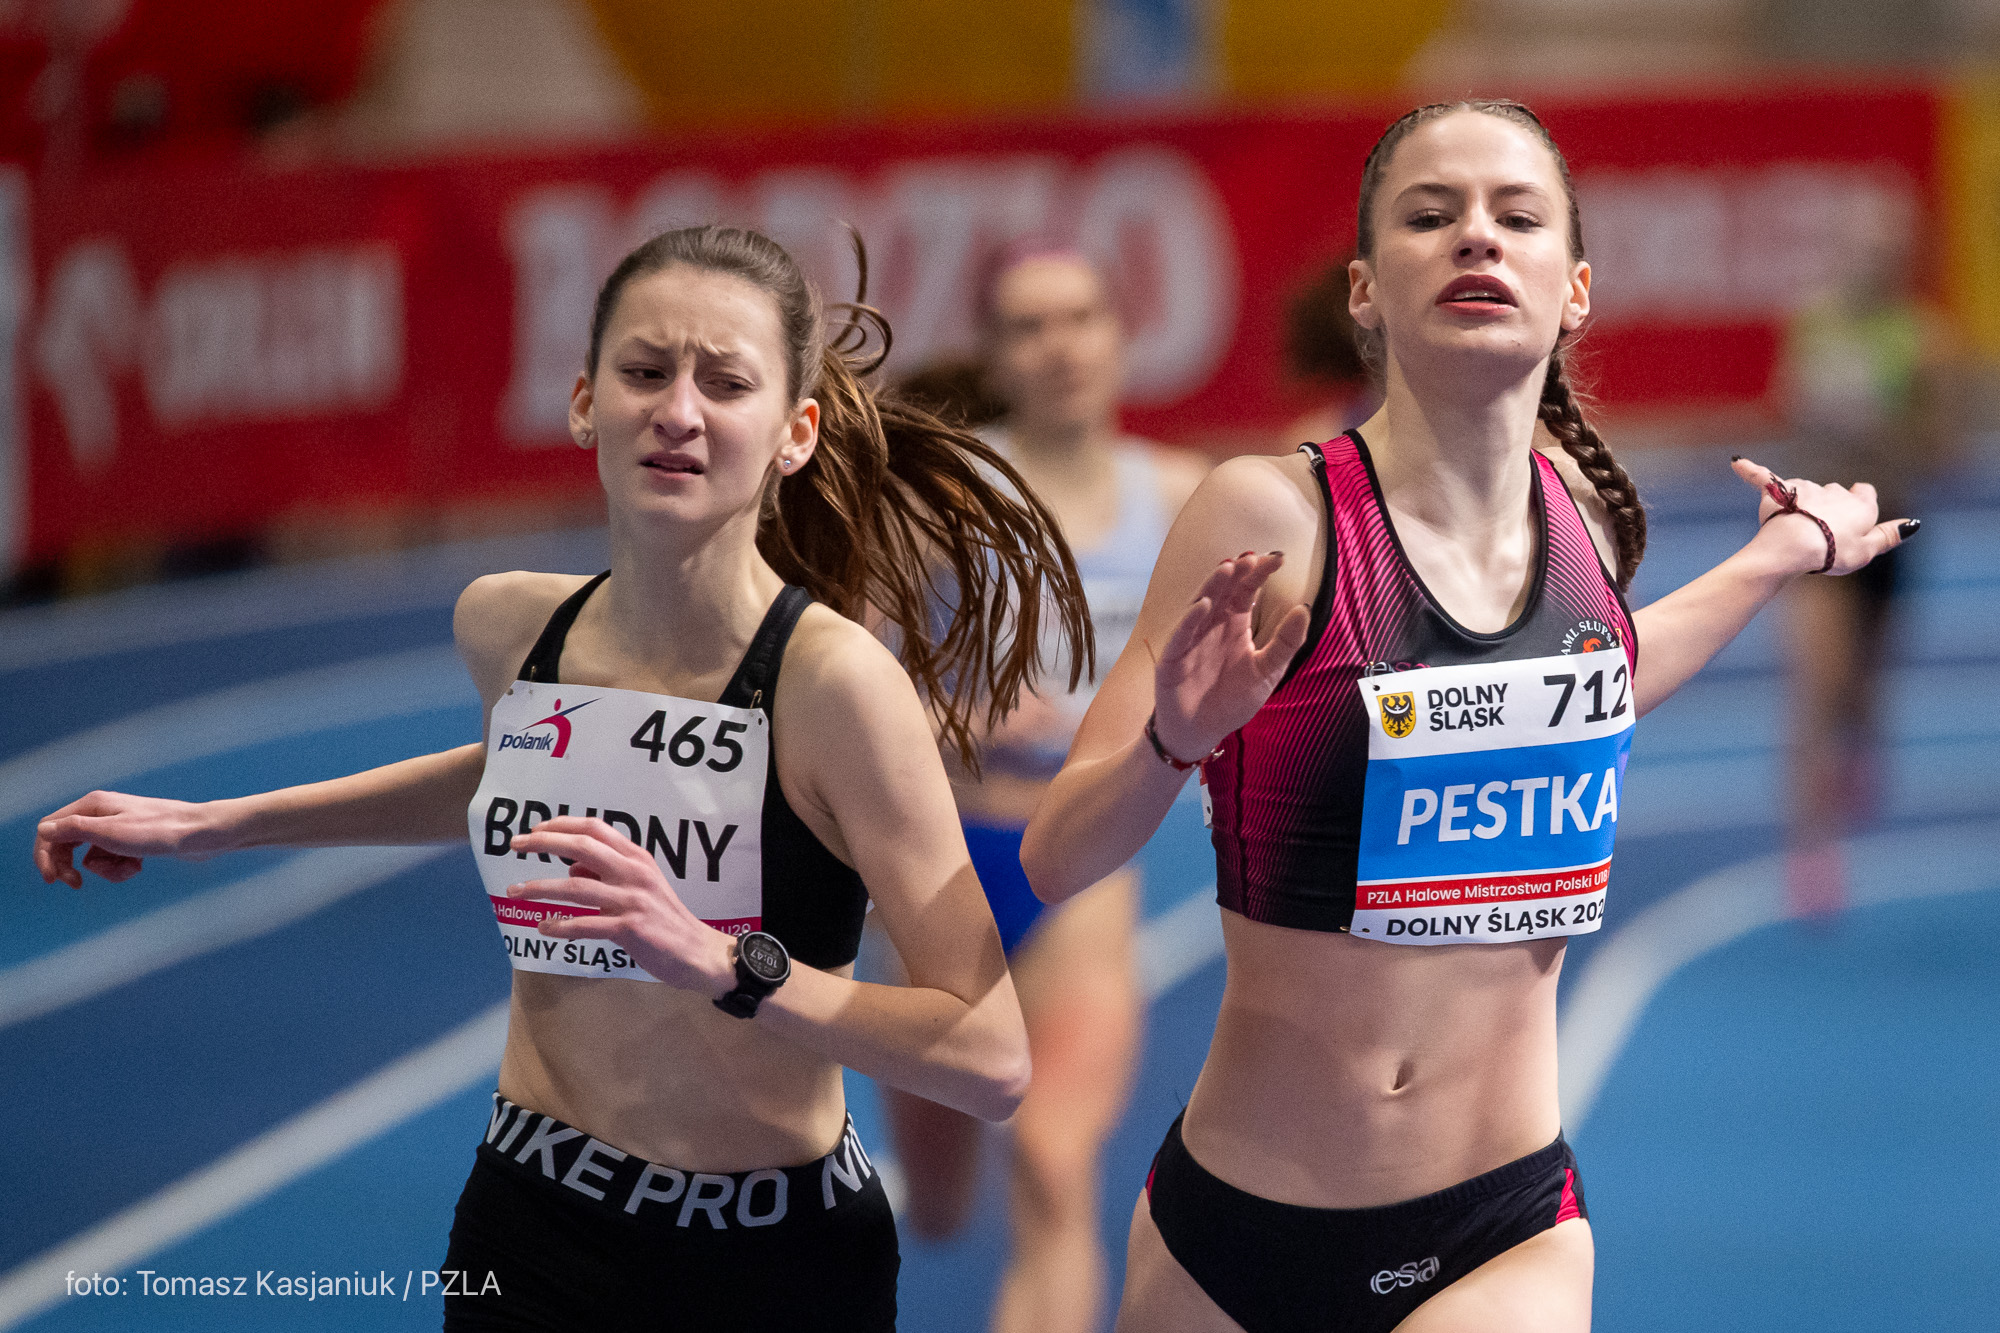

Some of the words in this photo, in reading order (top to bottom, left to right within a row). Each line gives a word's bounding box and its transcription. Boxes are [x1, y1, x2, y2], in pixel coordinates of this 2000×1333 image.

[1428, 683, 1508, 709] DOLNY
[1543, 664, 1627, 728] 712
[1430, 706, 1505, 732] ŚLĄSK
[498, 732, 554, 751] polanik
[630, 710, 748, 773] 465
[1397, 767, 1618, 845] PESTKA
[1367, 890, 1402, 904] PZLA
[1406, 887, 1461, 903] Halowe
[1465, 881, 1551, 899] Mistrzostwa
[1555, 874, 1593, 892] Polski
[498, 904, 542, 922] Halowe
[1386, 915, 1481, 937] DOLNY
[1488, 907, 1567, 934] ŚLĄSK
[1573, 898, 1604, 925] 202
[504, 934, 558, 961] OLNY
[563, 938, 636, 972] ŚLĄS
[624, 1162, 789, 1230] PRO
[822, 1111, 872, 1210] NI
[1370, 1256, 1441, 1295] esa
